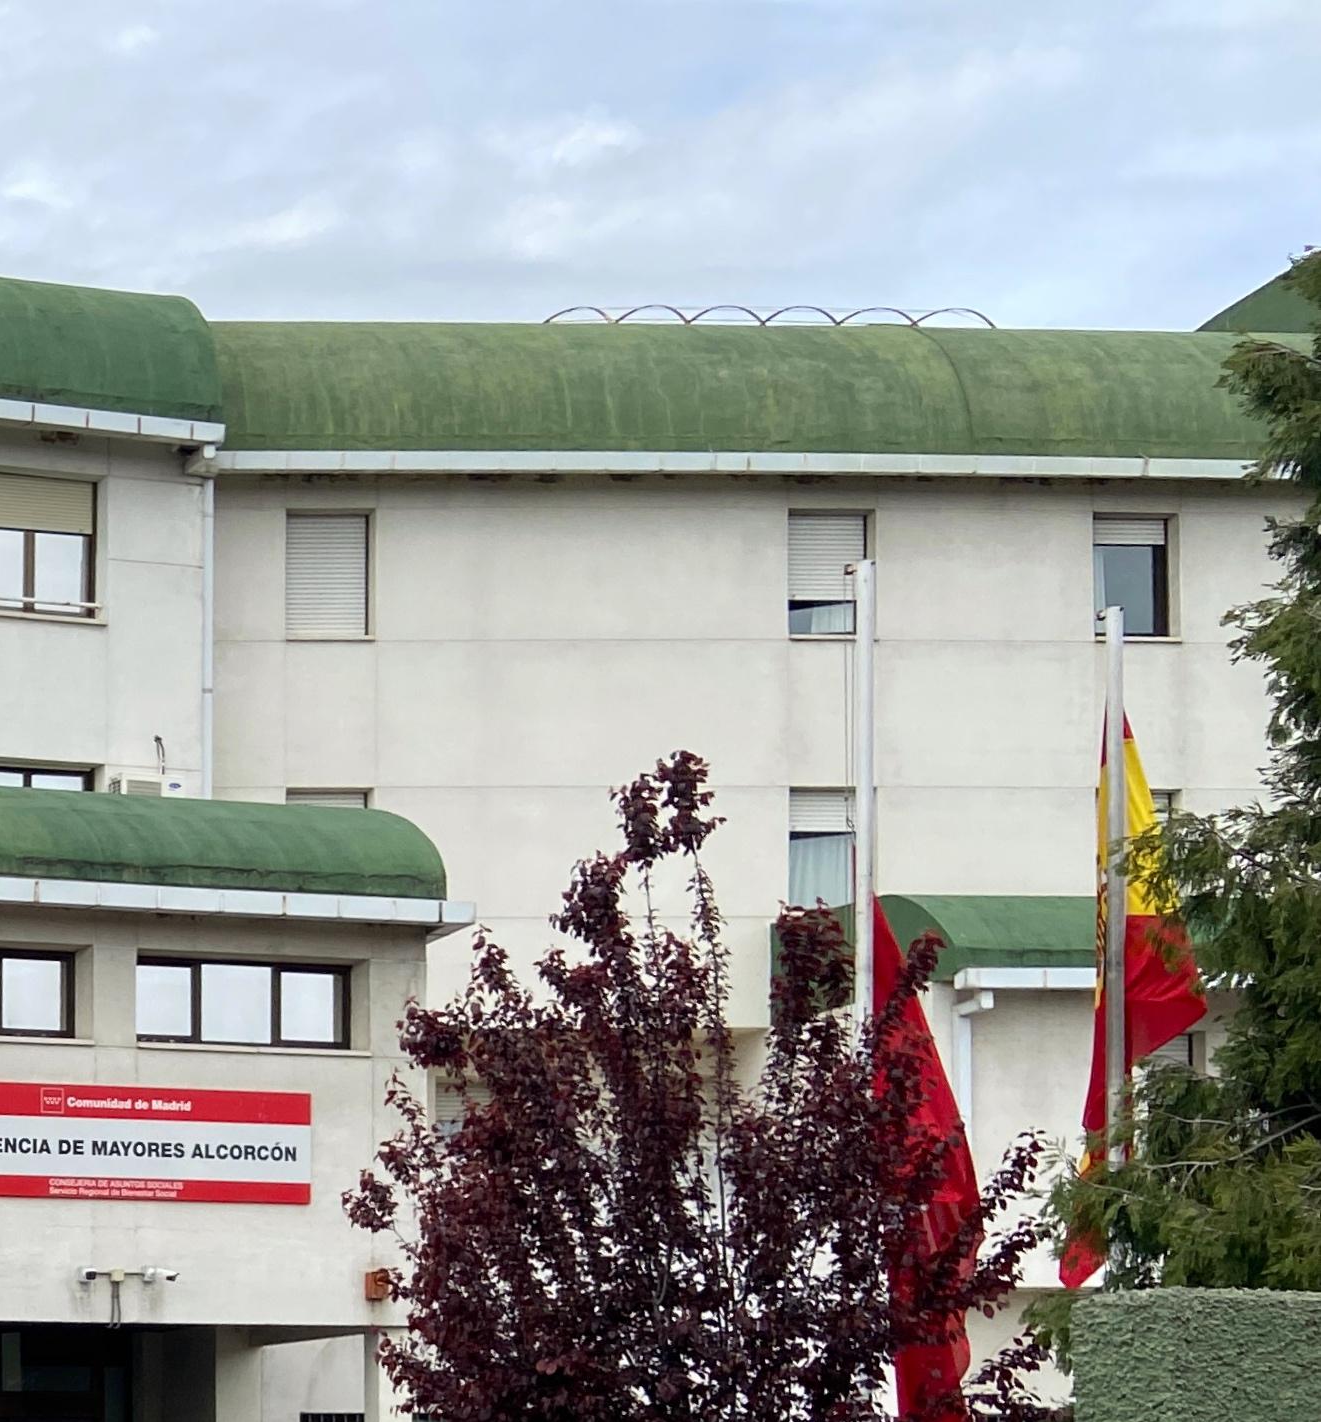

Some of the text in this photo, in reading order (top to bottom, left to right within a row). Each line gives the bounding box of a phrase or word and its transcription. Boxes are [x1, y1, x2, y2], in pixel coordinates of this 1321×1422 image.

[66, 1096, 192, 1112] Comunidad de Madrid
[58, 1139, 84, 1155] DE
[91, 1140, 185, 1158] MAYORES
[191, 1142, 297, 1162] ALCORCÓN
[97, 1179, 108, 1187] DE
[109, 1179, 145, 1189] ASUNTOS
[146, 1180, 184, 1190] SOCIALES
